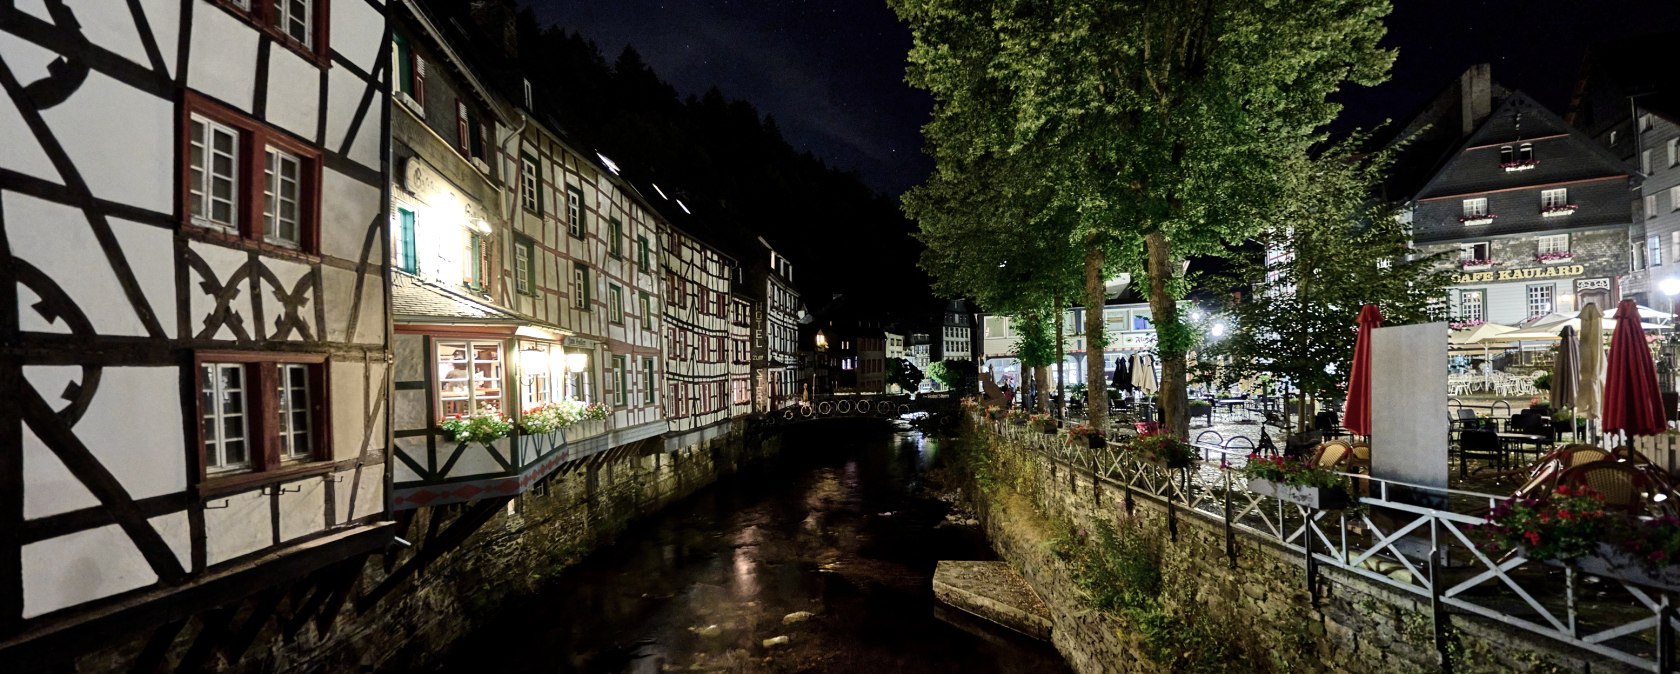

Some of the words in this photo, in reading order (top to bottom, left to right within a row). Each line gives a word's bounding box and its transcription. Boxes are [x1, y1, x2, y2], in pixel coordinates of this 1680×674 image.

[1498, 265, 1584, 280] KAULARD
[755, 301, 763, 348] HOTEL
[755, 368, 763, 412] STERN
